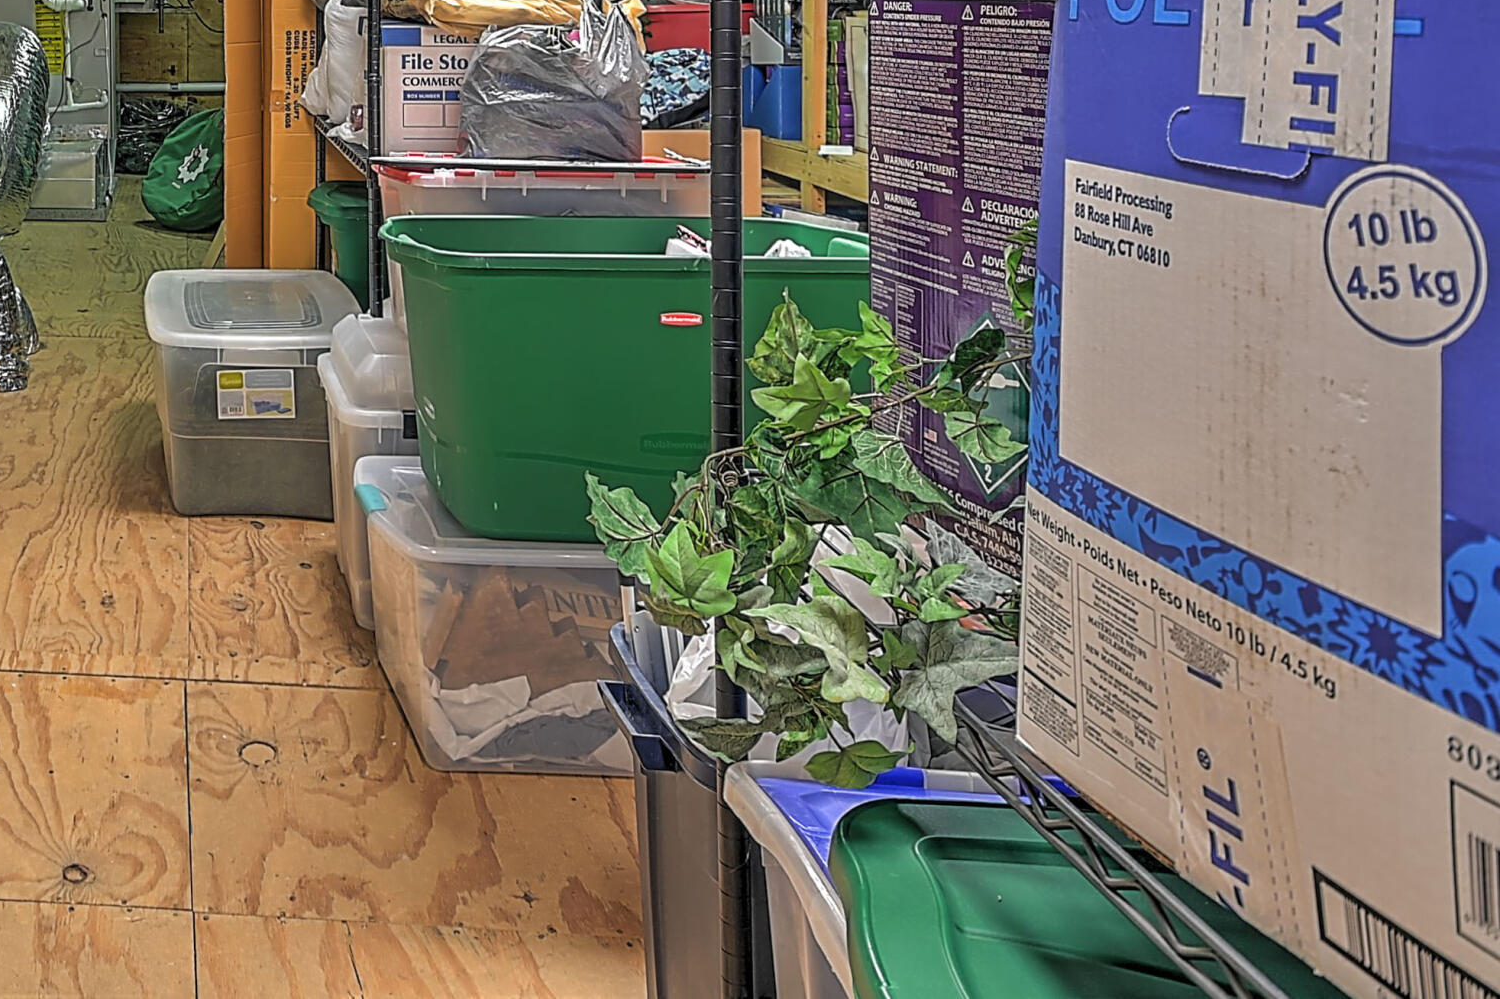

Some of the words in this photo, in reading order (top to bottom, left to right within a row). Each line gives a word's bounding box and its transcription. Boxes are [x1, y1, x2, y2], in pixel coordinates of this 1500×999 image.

[883, 1, 913, 12] DANGER:
[980, 4, 1018, 17] PELIGRO:
[979, 17, 1011, 26] CONTENIDO
[1011, 19, 1026, 27] BAJO
[1026, 18, 1051, 28] PRESIÓN
[433, 34, 469, 44] LEGAL
[301, 52, 307, 61] IN
[401, 53, 434, 70] File
[284, 113, 292, 129] KGS
[883, 154, 915, 169] WARNING
[915, 160, 959, 178] STATEMENT:
[883, 191, 918, 209] WARNING:
[1075, 177, 1113, 202] Fairfield
[1115, 186, 1173, 220] Processing
[1074, 202, 1086, 219] 88
[1087, 205, 1111, 226] Rose
[1112, 211, 1131, 231] Hill
[1132, 217, 1154, 237] Ave
[1348, 212, 1390, 247] 10
[1399, 209, 1438, 244] lb
[1074, 226, 1117, 257] Danbury,
[1117, 239, 1135, 258] CT
[1136, 243, 1171, 268] 06810
[1346, 264, 1400, 300] 4.5
[1408, 262, 1461, 307] kg
[660, 315, 702, 323] Rubbermaid
[984, 464, 993, 483] 2
[1001, 531, 1021, 552] Air)
[1026, 501, 1041, 520] Net
[1041, 511, 1076, 548] Weight
[1083, 538, 1115, 571] Poids
[1117, 558, 1140, 587] Net
[1150, 577, 1183, 610] Peso
[1185, 597, 1222, 632] Neto
[1226, 622, 1246, 646] 10
[1249, 632, 1265, 657] lb
[1280, 652, 1308, 680] 4.5
[1313, 665, 1337, 700] kg
